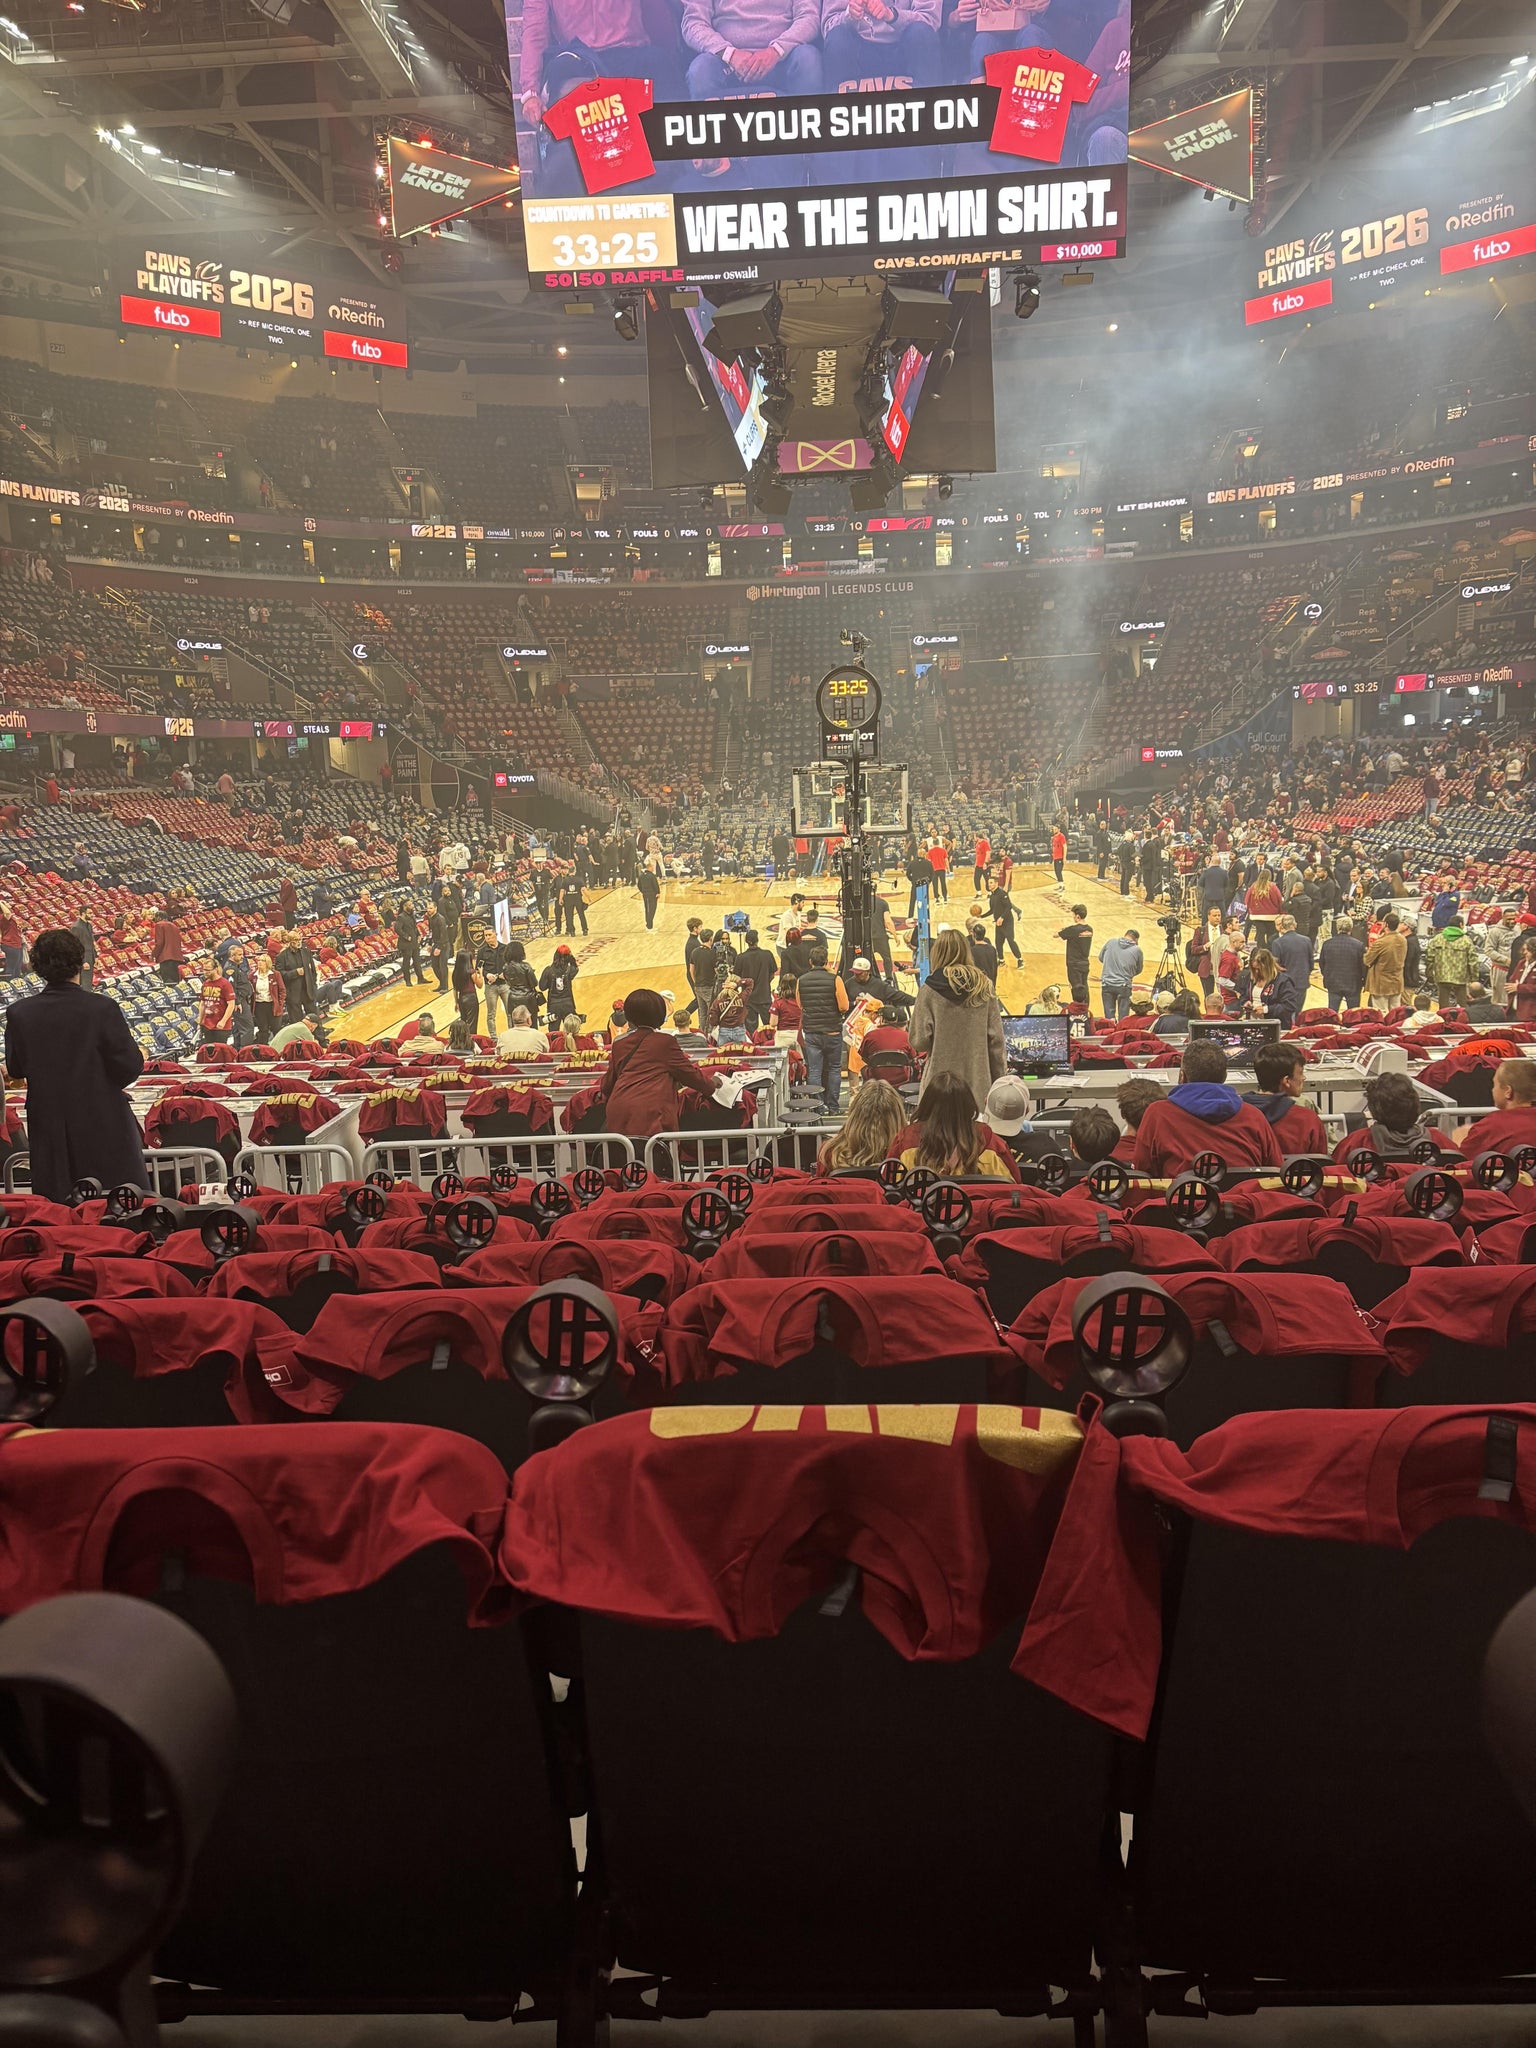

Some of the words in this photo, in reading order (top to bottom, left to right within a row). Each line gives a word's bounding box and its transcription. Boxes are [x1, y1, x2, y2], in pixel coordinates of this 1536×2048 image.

[1014, 65, 1065, 94] CAVS
[1011, 87, 1061, 103] PLAYOFFS
[575, 93, 625, 127] CAVS
[581, 115, 628, 136] PLAYOFFS
[664, 113, 726, 146] PUT
[733, 108, 821, 142] YOUR
[830, 101, 926, 137] SHIRT
[933, 97, 979, 131] ON
[1163, 129, 1197, 151] LET
[1198, 118, 1228, 137] EM
[1170, 129, 1238, 162] KNOW.
[407, 162, 444, 180] LET
[443, 172, 471, 188] EM
[400, 172, 465, 200] KNOW.
[1459, 195, 1493, 210] PRESENTED
[1495, 193, 1504, 201] BY
[682, 201, 790, 253] WEAR
[803, 197, 869, 248] THE
[878, 188, 987, 243] DAMN
[997, 179, 1118, 234] SHIRT.
[1461, 203, 1515, 229] Redfin
[1341, 207, 1429, 265] 2026
[552, 231, 659, 267] 33:25
[1056, 243, 1102, 259] $10,000
[1264, 238, 1305, 267] CAVS
[1472, 239, 1511, 262] fubo
[145, 250, 191, 277] CAVS
[874, 249, 1022, 269] CAVS.COM/RAFFLE
[611, 269, 684, 285] RAFFLE
[723, 265, 759, 280] oswald
[1257, 250, 1336, 289] PLAYOFFS
[1358, 271, 1371, 281] REF
[136, 270, 225, 304] PLAYOFFS
[229, 269, 314, 320] 2026
[340, 297, 367, 308] PRESENTED
[369, 302, 377, 310] BY
[1272, 293, 1304, 314] fubo
[154, 306, 190, 327] fubo
[341, 305, 385, 328] Redfin
[248, 320, 260, 329] REF
[351, 339, 381, 359] fubo
[811, 349, 837, 374] Arena
[1207, 489, 1235, 505] CAVS
[1238, 481, 1295, 502] PLAYOFFS
[1313, 473, 1343, 491] 2026
[1346, 468, 1387, 482] PRESENTED
[1391, 465, 1400, 474] BY
[1416, 455, 1455, 471] Redfin
[0, 479, 20, 497] AVS
[21, 484, 80, 506] PLAYOFFS
[98, 495, 130, 512] 2026
[132, 503, 172, 516] PRESENTED
[175, 509, 184, 517] BY
[197, 511, 235, 525] Redfin
[1117, 504, 1137, 512] LET
[1137, 501, 1152, 510] EM
[1153, 498, 1187, 508] KNOW.
[983, 514, 1009, 523] FOULS
[1016, 513, 1022, 522] 0
[1033, 511, 1050, 520] TOL
[1056, 509, 1062, 518] 7
[1073, 507, 1089, 516] 6:30
[1090, 506, 1102, 515] PM
[814, 523, 835, 532] 33:25
[850, 521, 863, 532] 1Q
[881, 520, 888, 530] 0
[937, 518, 954, 526] FG%
[962, 517, 968, 526] 0
[487, 528, 510, 537] oswald
[521, 530, 545, 538] $10,000
[594, 530, 610, 538] TOL
[616, 530, 622, 538] 7
[633, 530, 658, 538] FOULS
[664, 529, 670, 538] 0
[680, 529, 699, 537] FG%
[706, 527, 712, 536] 0
[762, 525, 768, 534] 0
[832, 582, 882, 595] LEGENDS
[885, 581, 914, 592] CLUB
[1475, 584, 1511, 594] LEXUS
[1132, 621, 1165, 630] LEXUS
[189, 642, 222, 650] LEXUS
[926, 635, 958, 643] LEXUS
[718, 645, 750, 653] LEXUS
[1437, 673, 1472, 685] PRESENTED
[1474, 673, 1481, 681] BY
[1489, 667, 1513, 682] Redfin
[828, 680, 868, 696] 33:25
[1327, 685, 1333, 695] 0
[1354, 682, 1378, 693] 33:25
[1399, 679, 1405, 689] 0
[0, 711, 27, 728] edfin
[179, 718, 194, 736] 26
[287, 725, 292, 734] 0
[303, 725, 329, 733] STEALS
[345, 725, 350, 734] 0
[1248, 732, 1263, 742] Full
[1265, 731, 1287, 742] Court
[839, 733, 874, 742] TISOT
[1155, 750, 1183, 758] TOYOTA
[397, 769, 417, 777] PAINT
[508, 775, 535, 783] TOYOTA
[1070, 1022, 1085, 1037] 45
